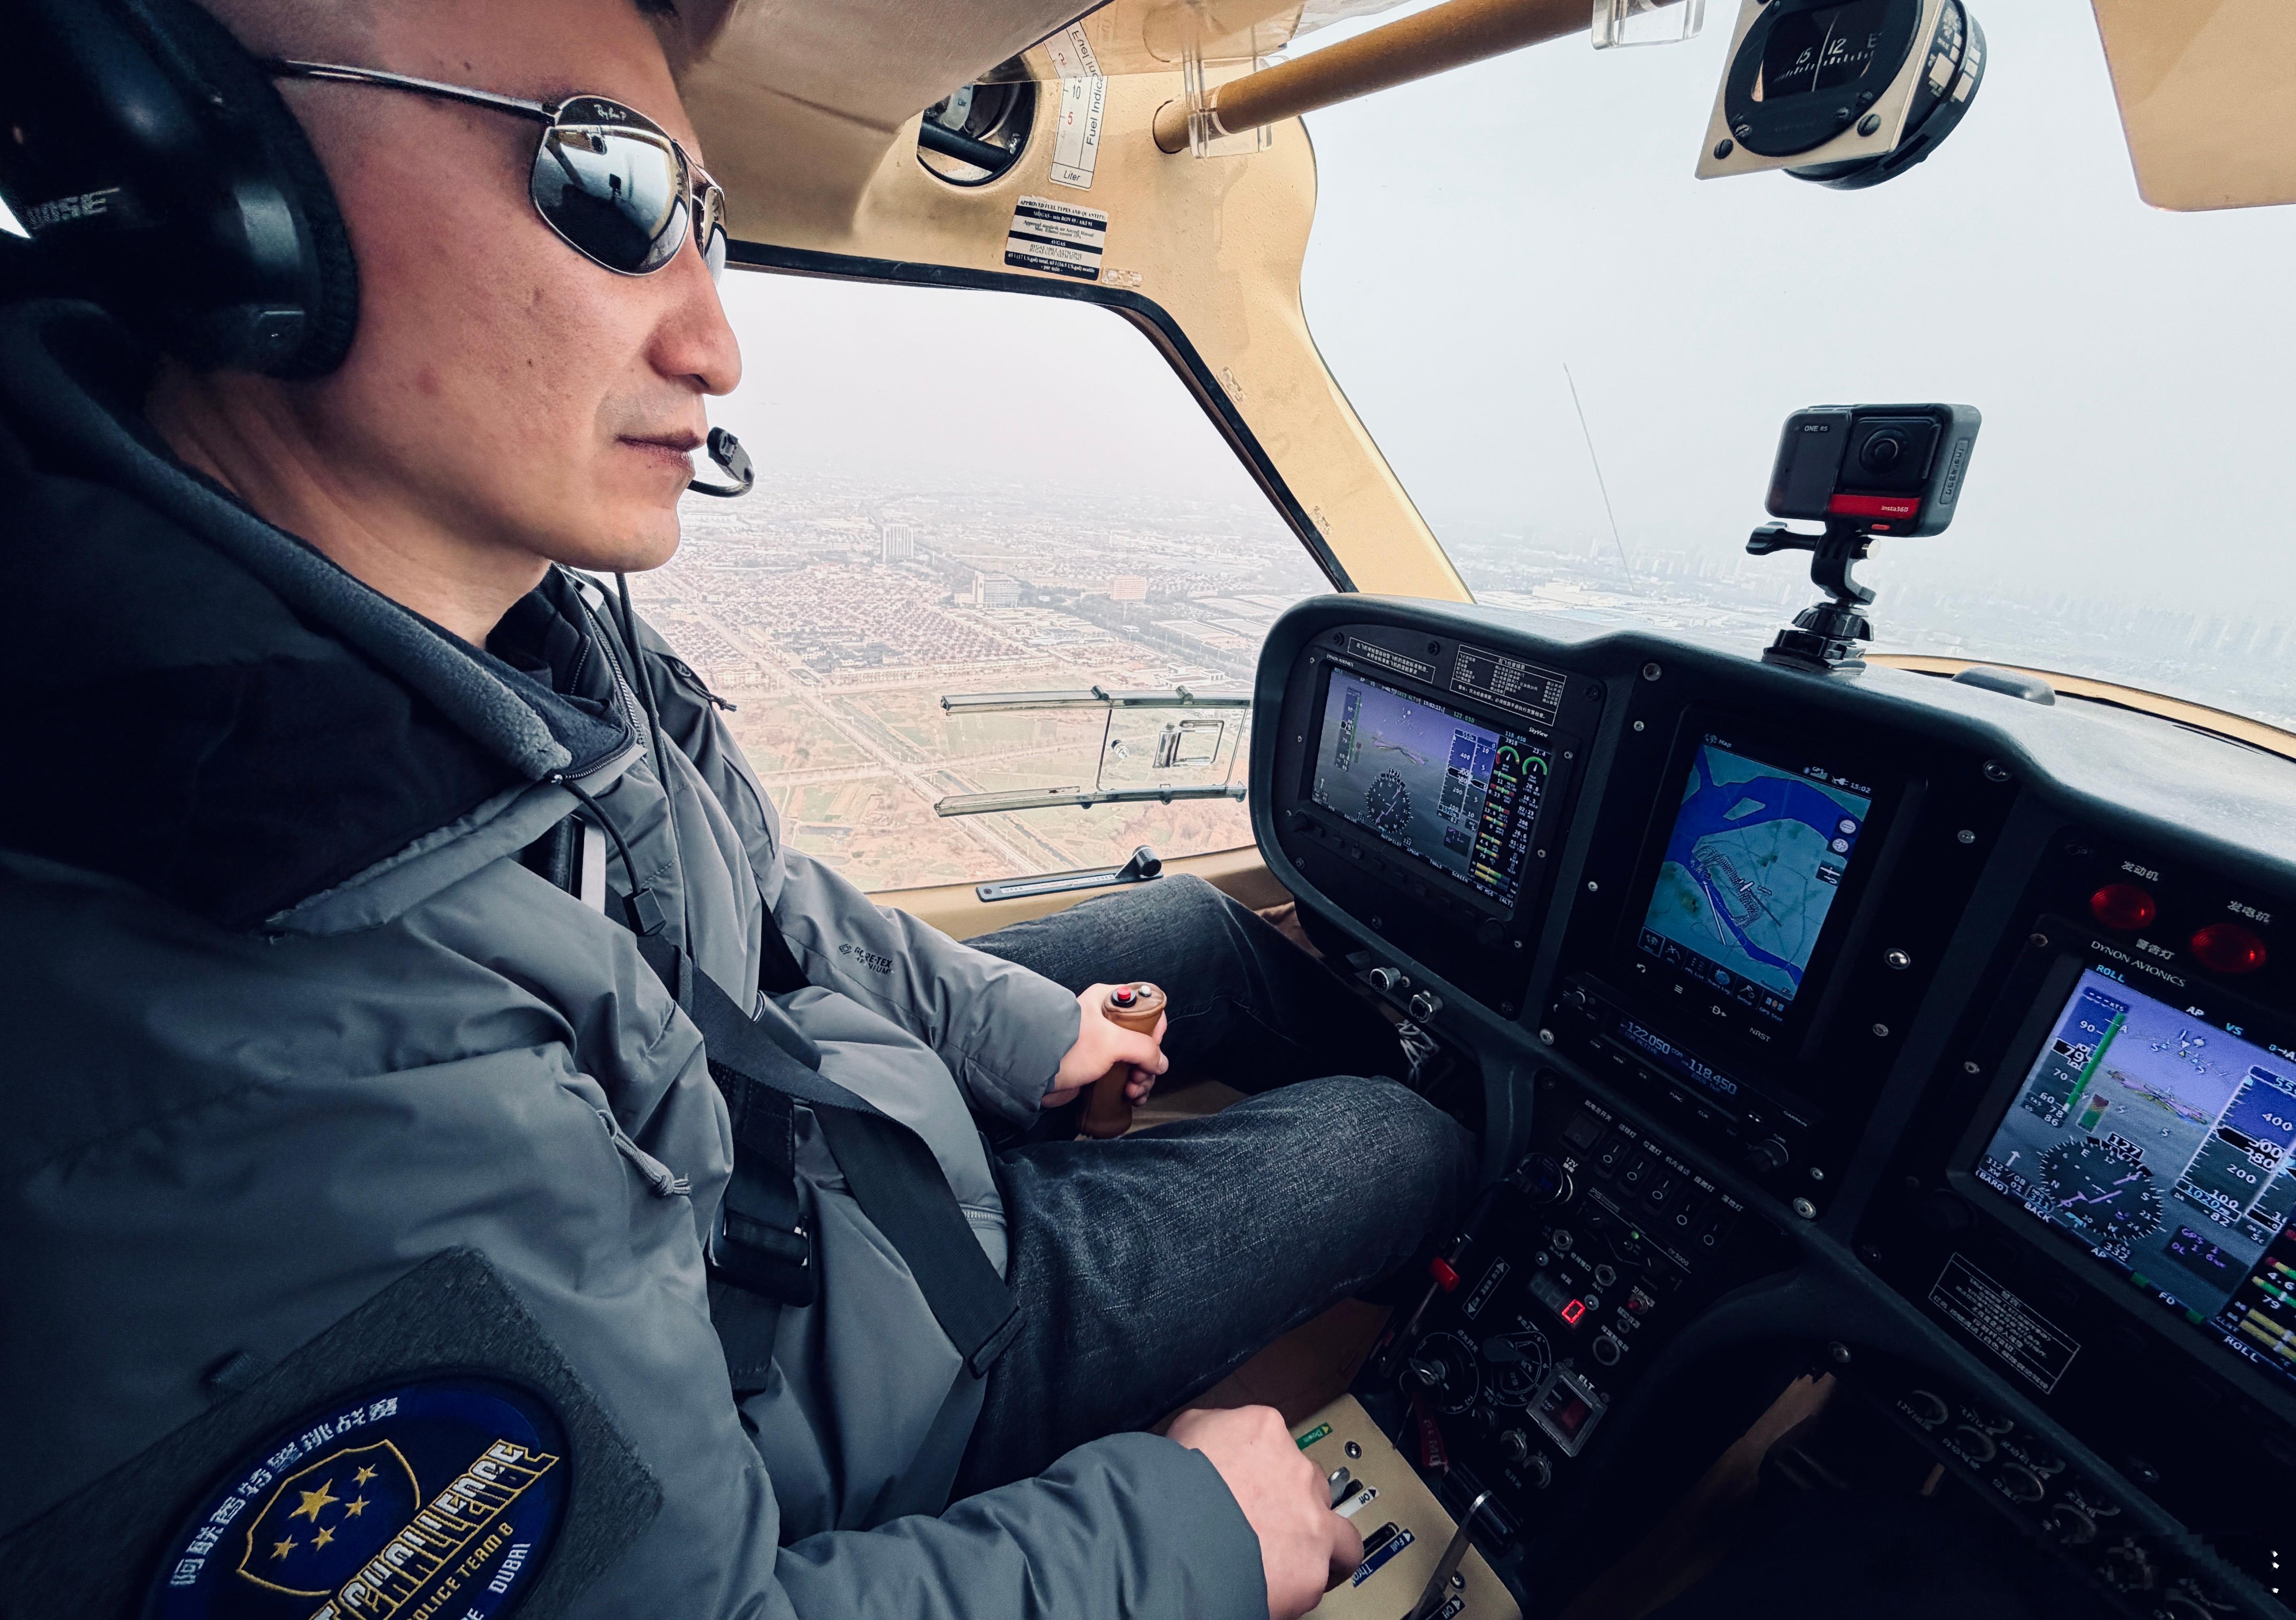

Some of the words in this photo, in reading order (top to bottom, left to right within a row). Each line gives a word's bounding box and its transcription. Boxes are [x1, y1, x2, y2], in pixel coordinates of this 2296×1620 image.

[1796, 47, 1812, 64] 15
[1828, 38, 1847, 55] 12
[1867, 33, 1877, 48] E
[1067, 111, 1073, 125] 5
[1086, 114, 1098, 146] Fuel
[1063, 170, 1080, 181] Liter
[1881, 505, 1909, 513] Insta360
[1529, 727, 1549, 738] SkyView
[1718, 739, 1732, 748] Map
[1453, 787, 1462, 795] 200
[1850, 783, 1871, 794] 15:02
[1430, 859, 1442, 869] TOOLS
[1452, 871, 1468, 883] SCREEN
[2121, 861, 2159, 882] 发动机
[2227, 900, 2272, 923] 发电机
[2091, 940, 2131, 963] DYNON
[2131, 959, 2186, 987] AVIONICS
[2096, 965, 2125, 983] ROLL
[2186, 1006, 2205, 1016] AP
[2226, 1023, 2243, 1035] VS
[2080, 1020, 2095, 1032] 90
[1749, 1027, 1772, 1042] NRST
[2064, 1045, 2084, 1062] 79
[1689, 1058, 1738, 1095] 118.450
[2053, 1068, 2068, 1081] 70
[2040, 1092, 2055, 1104] 60
[2049, 1106, 2064, 1118] 78
[2044, 1115, 2059, 1127] 86
[2262, 1113, 2293, 1131] 400
[2109, 1135, 2142, 1155] 127
[1566, 1156, 1578, 1168] 12V
[2081, 1149, 2090, 1157] E
[2104, 1156, 2115, 1165] 12
[1988, 1167, 2001, 1177] XW
[2010, 1181, 2023, 1192] 01
[2226, 1164, 2256, 1184] 200
[2051, 1180, 2060, 1188] N
[2029, 1194, 2050, 1210] 311
[2141, 1192, 2150, 1201] S
[2210, 1190, 2239, 1208] 100
[2082, 1214, 2093, 1223] 30
[2204, 1210, 2230, 1227] -82
[2104, 1243, 2128, 1261] 332
[1975, 1169, 2009, 1195] (BARO)
[2024, 1202, 2050, 1223] BACK
[2090, 1248, 2107, 1258] AP
[2159, 1292, 2175, 1305] FD
[2223, 1335, 2259, 1363] ROLL
[2267, 1272, 2295, 1290] 4.6
[2263, 1294, 2281, 1310] 79
[1578, 1374, 1595, 1390] ELT
[1358, 1493, 1371, 1505] Off
[1390, 1538, 1404, 1552] Full
[487, 1543, 531, 1594] DUBAI
[407, 1576, 461, 1620] OLICE
[453, 1534, 503, 1578] TEAM
